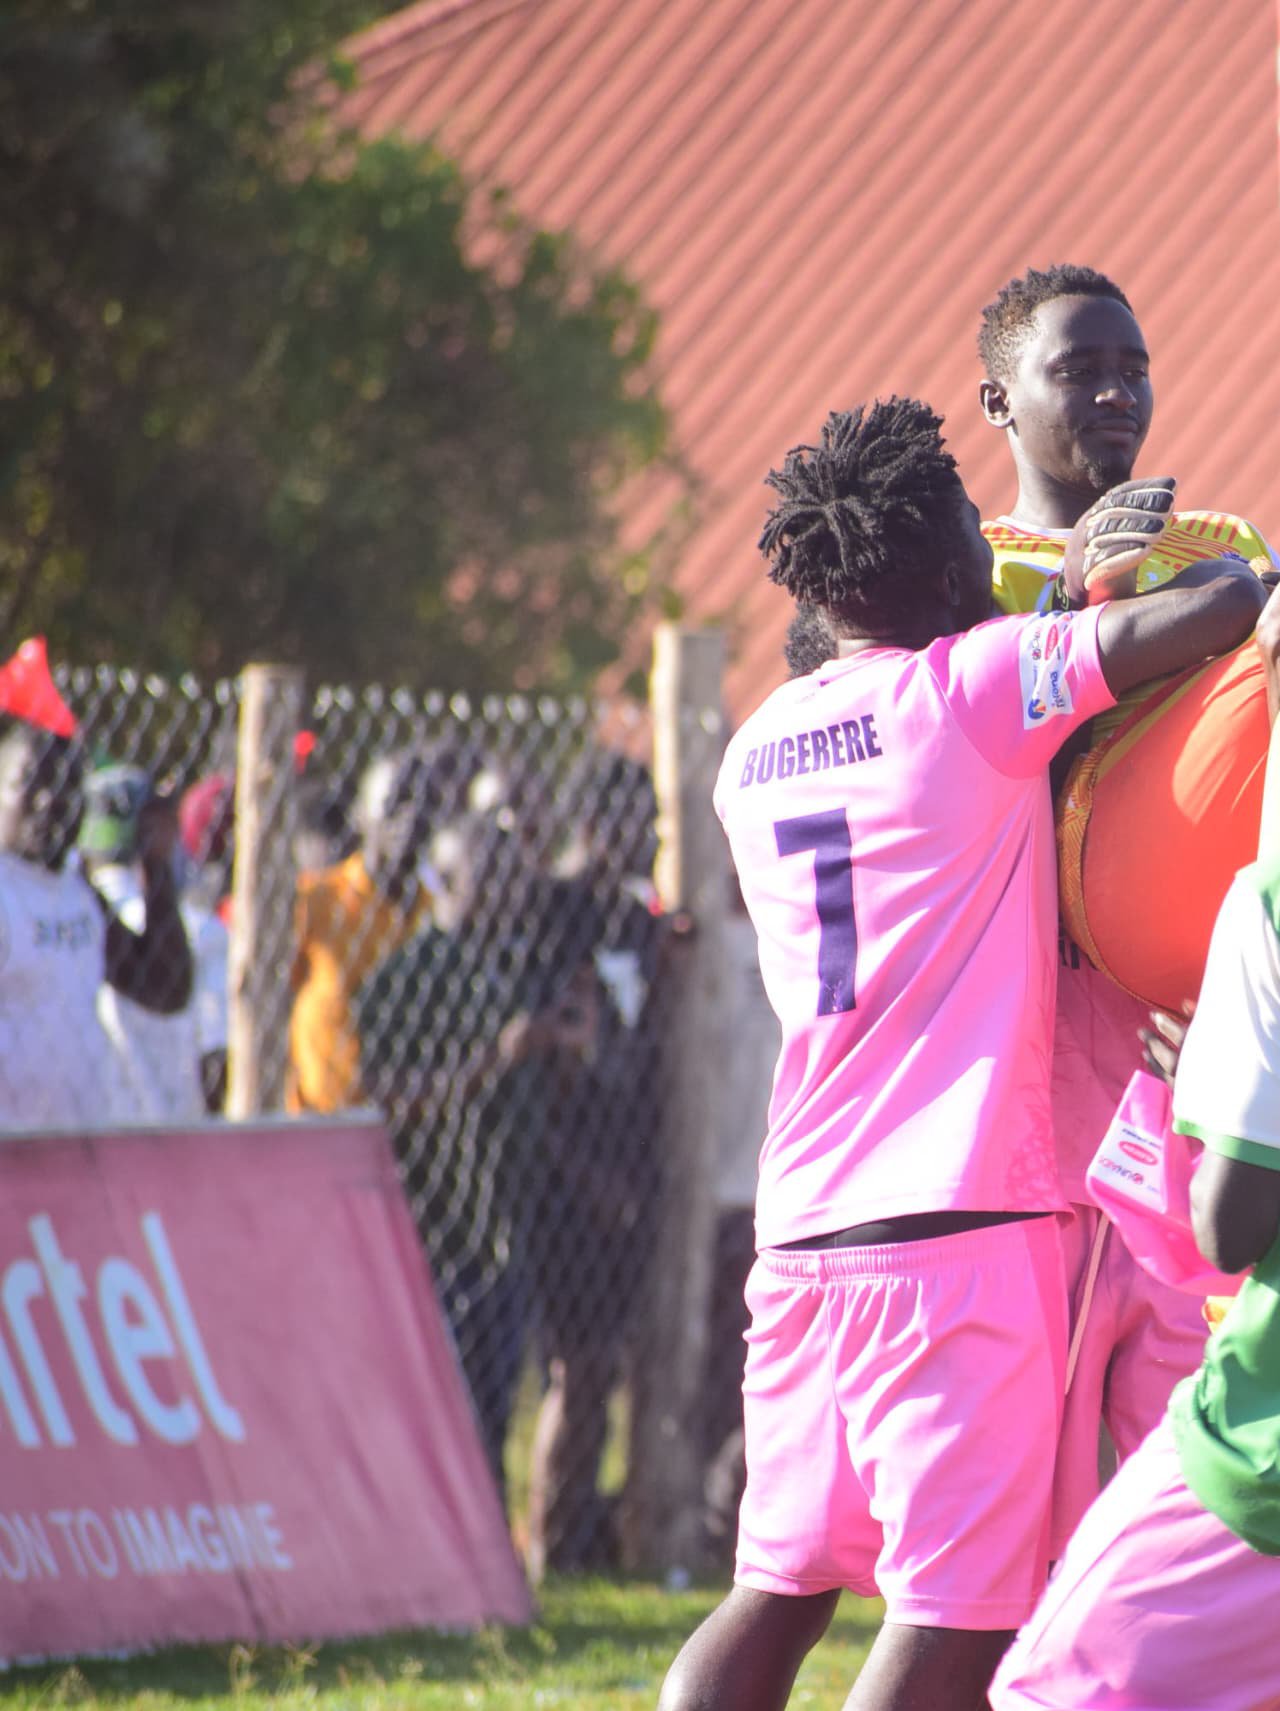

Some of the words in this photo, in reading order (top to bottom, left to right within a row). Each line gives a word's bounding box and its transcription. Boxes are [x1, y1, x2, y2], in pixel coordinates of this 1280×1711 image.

[739, 713, 883, 788] BUGERERE
[773, 807, 858, 1017] 7
[48, 1508, 119, 1579] TO
[110, 1503, 294, 1578] IMAGINE
